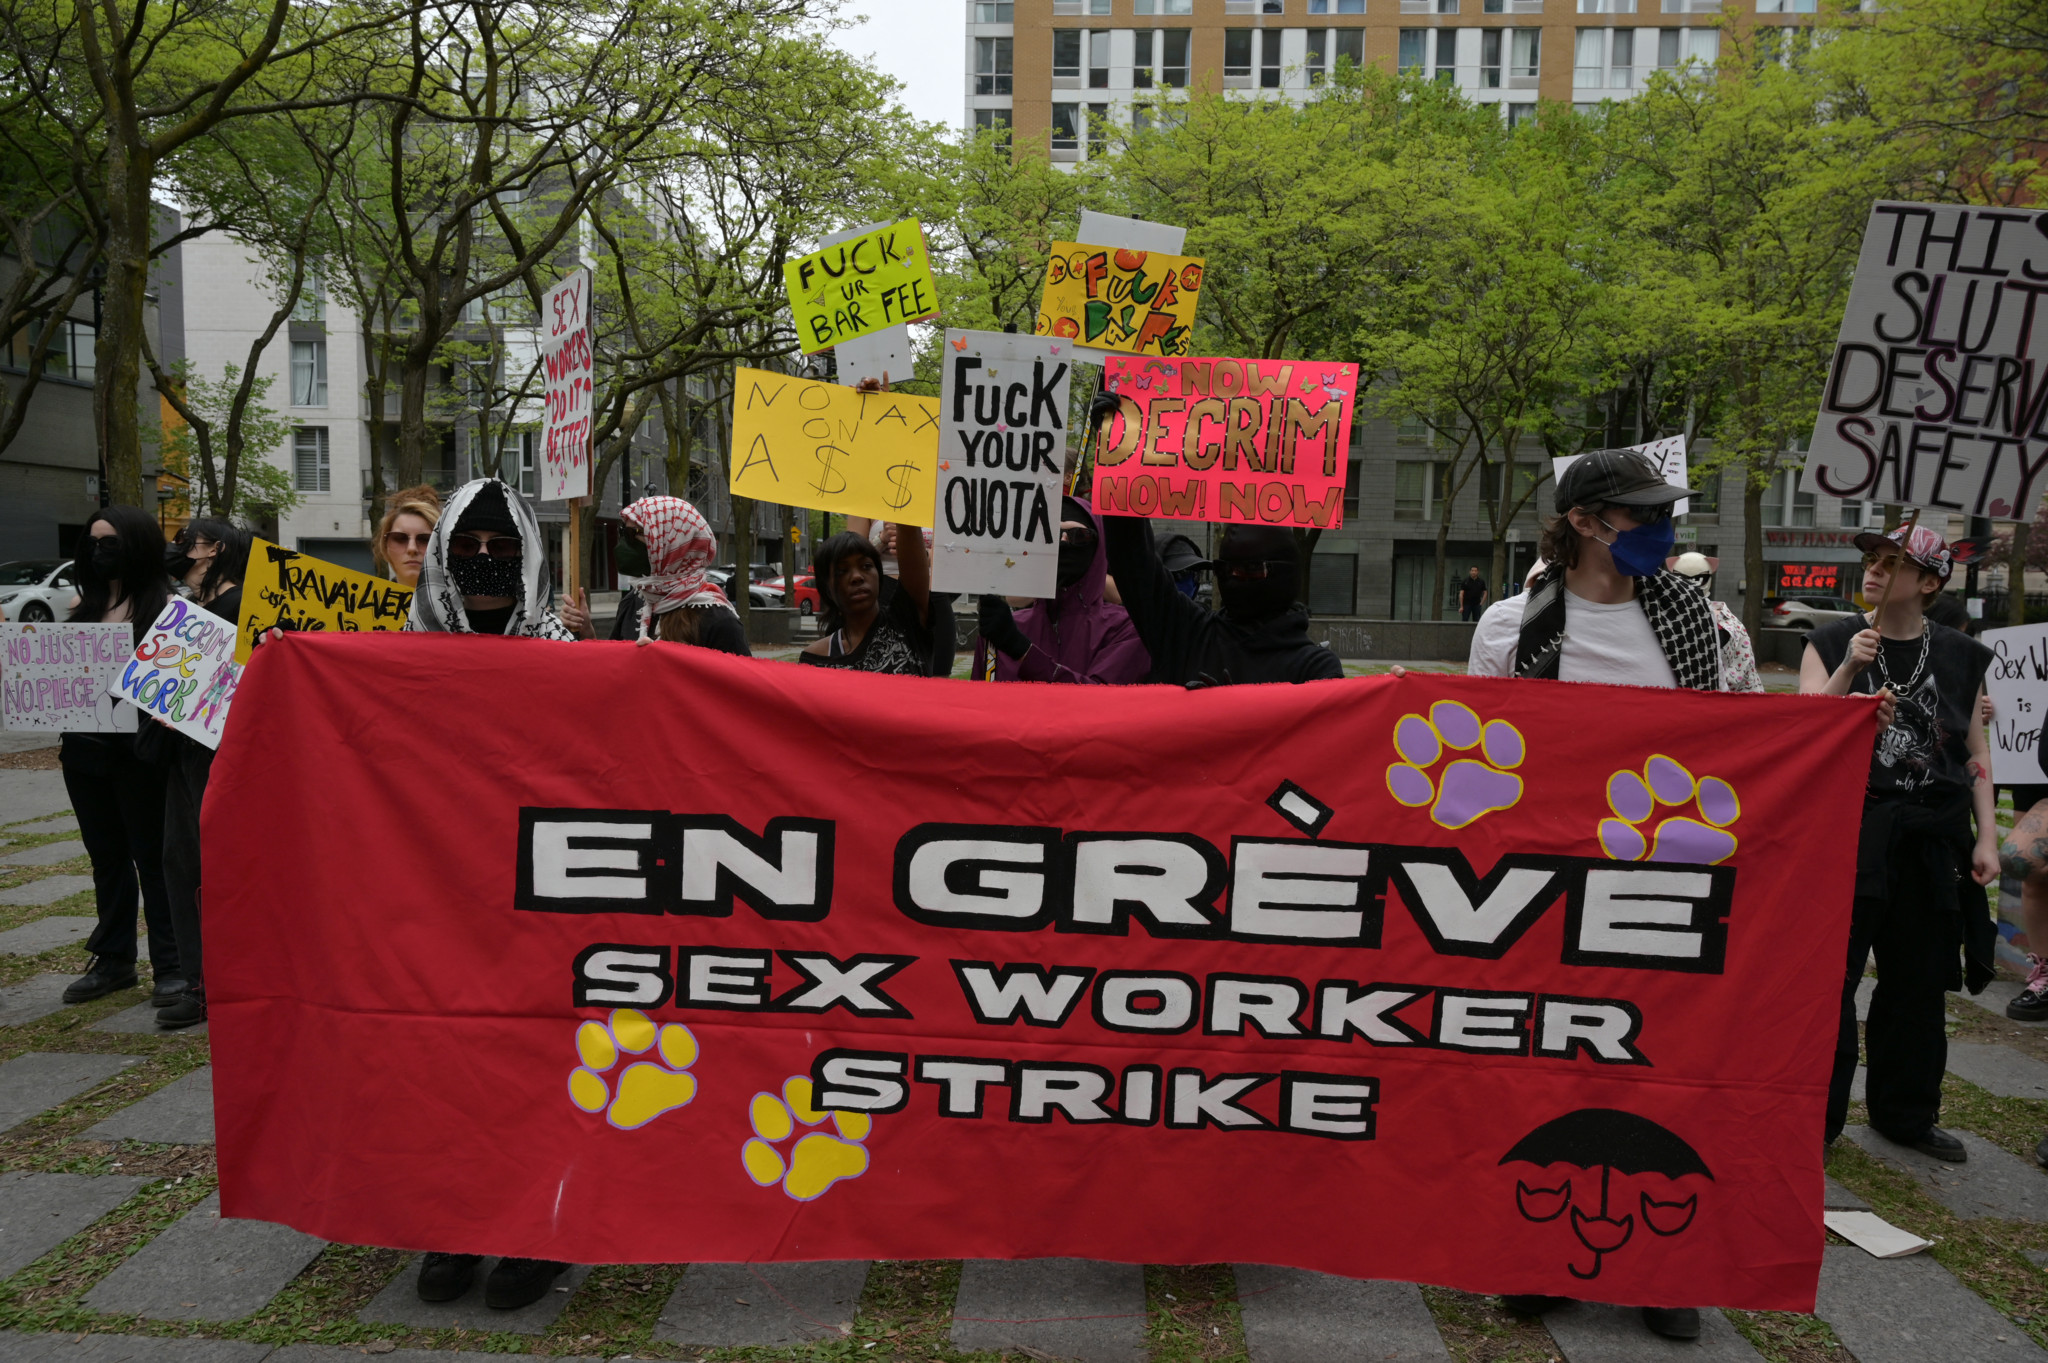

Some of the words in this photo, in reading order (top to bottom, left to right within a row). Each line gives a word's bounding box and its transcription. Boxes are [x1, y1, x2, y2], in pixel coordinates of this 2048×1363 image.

[799, 234, 901, 291] FUCK
[1085, 251, 1179, 311] FUCK
[552, 278, 581, 337] SEX
[809, 301, 870, 344] BAR
[881, 279, 932, 324] FEE
[840, 279, 869, 302] UR
[1084, 300, 1138, 346] BAR
[545, 327, 591, 383] WORKERS
[1180, 361, 1294, 398] NOW
[552, 388, 567, 424] DO
[569, 377, 583, 412] IT
[546, 415, 588, 468] BETTER
[802, 418, 859, 442] ON
[957, 429, 1061, 474] YOUR
[1096, 394, 1344, 477] DECRIM
[1815, 415, 2048, 520] SAFETY
[944, 476, 1054, 544] QUOTA
[1100, 475, 1207, 518] NOW!
[1219, 480, 1344, 530] NOW!
[7, 636, 31, 666] NO
[36, 632, 131, 665] JUSTICE
[135, 633, 203, 679] Sex
[155, 600, 236, 662] DECRIM
[1993, 639, 2027, 681] Sex
[4, 679, 35, 715] NO
[36, 677, 97, 712] PIECE
[122, 659, 198, 723] WORK
[2017, 698, 2032, 713] is
[522, 813, 827, 914] EN
[901, 785, 1724, 965] GRÈVE
[578, 947, 905, 1014] SEX
[956, 964, 1643, 1064] WORKER
[816, 1053, 1375, 1137] STRIKE
